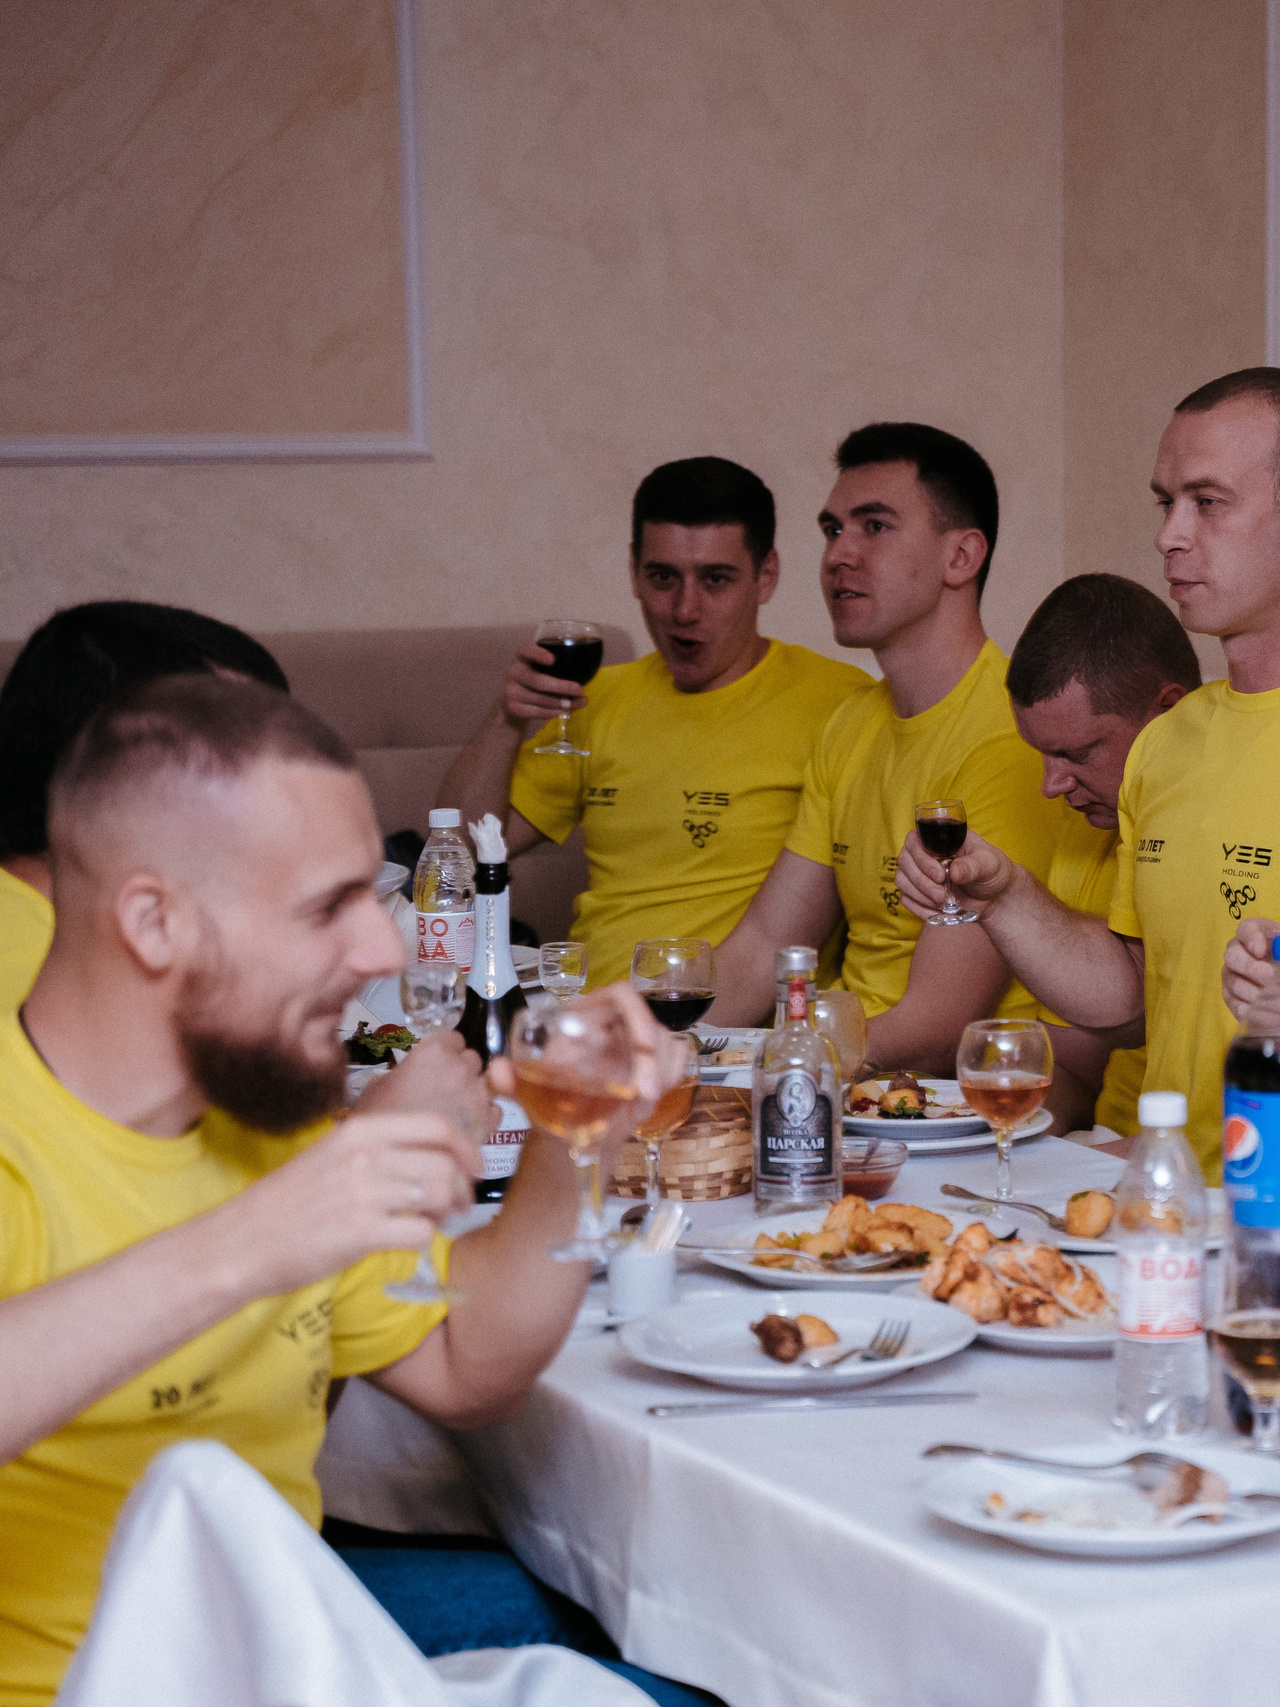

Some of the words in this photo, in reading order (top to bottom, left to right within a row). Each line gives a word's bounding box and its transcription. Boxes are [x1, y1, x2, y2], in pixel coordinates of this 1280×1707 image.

[682, 789, 730, 806] YES
[1146, 839, 1165, 853] ЛЕТ
[1222, 842, 1273, 867] YES
[882, 855, 900, 872] YE
[1222, 868, 1260, 880] HOLDING
[487, 1131, 528, 1145] TEFAN
[767, 1136, 825, 1151] ЦАРСКАЯ
